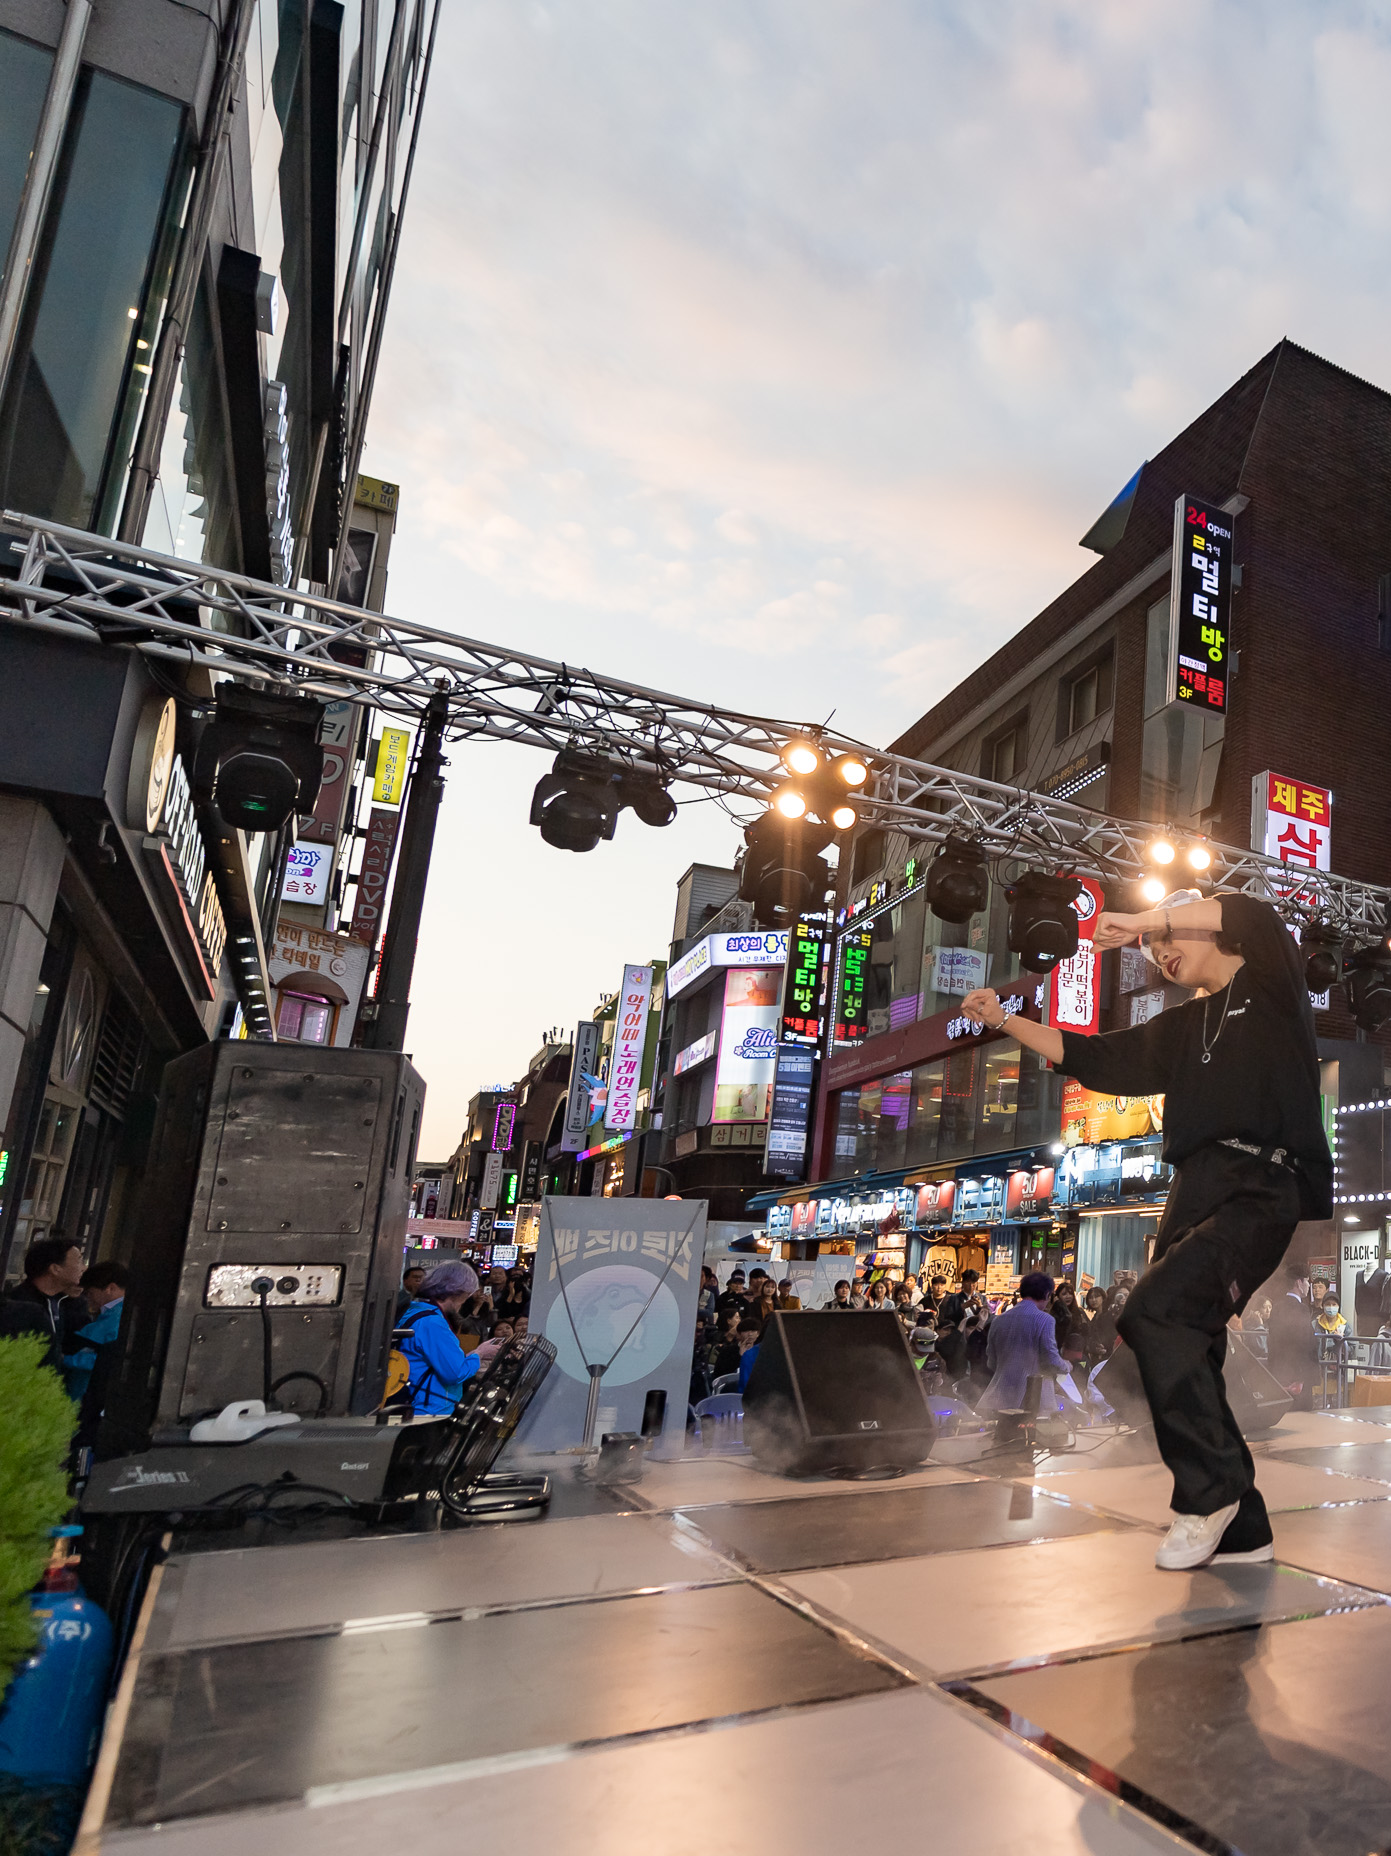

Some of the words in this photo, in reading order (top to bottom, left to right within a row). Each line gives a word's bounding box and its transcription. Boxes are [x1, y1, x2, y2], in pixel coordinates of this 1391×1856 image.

[1187, 505, 1207, 529] 24
[1191, 551, 1226, 663] 멀티방
[1178, 667, 1225, 708] 커플룸
[1178, 685, 1194, 700] 3F
[381, 733, 402, 795] 보드게임카페
[1272, 780, 1325, 820] 제주
[286, 879, 318, 897] 습장
[357, 871, 386, 920] DVD
[308, 932, 347, 958] 만드는
[727, 936, 761, 953] 최상의
[793, 940, 820, 1013] 멀티방
[743, 1027, 787, 1048] Alic
[783, 1016, 819, 1038] 커플룸
[784, 1031, 797, 1041] 3F
[925, 1209, 940, 1222] SALE
[1019, 1199, 1037, 1217] SALE
